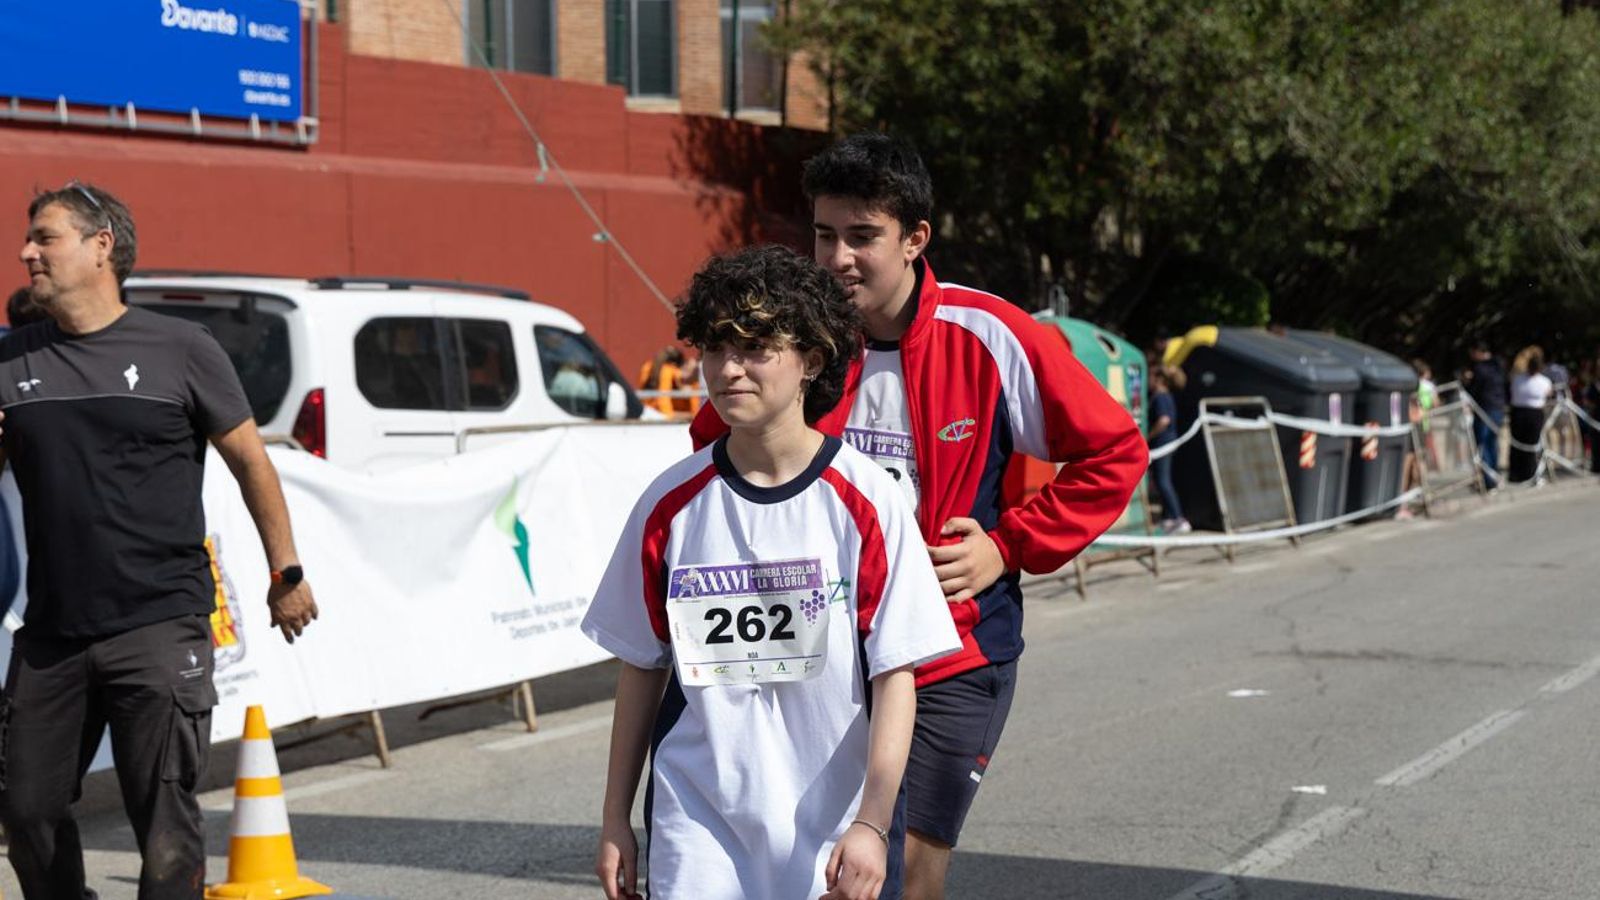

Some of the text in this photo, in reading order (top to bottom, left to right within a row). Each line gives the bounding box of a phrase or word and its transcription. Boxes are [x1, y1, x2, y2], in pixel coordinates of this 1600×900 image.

[161, 0, 238, 35] Davante
[876, 443, 887, 453] LA
[697, 564, 817, 593] XXXVI CARRERA ESCOLAR
[757, 575, 807, 589] LA GLORIA
[704, 604, 796, 645] 262
